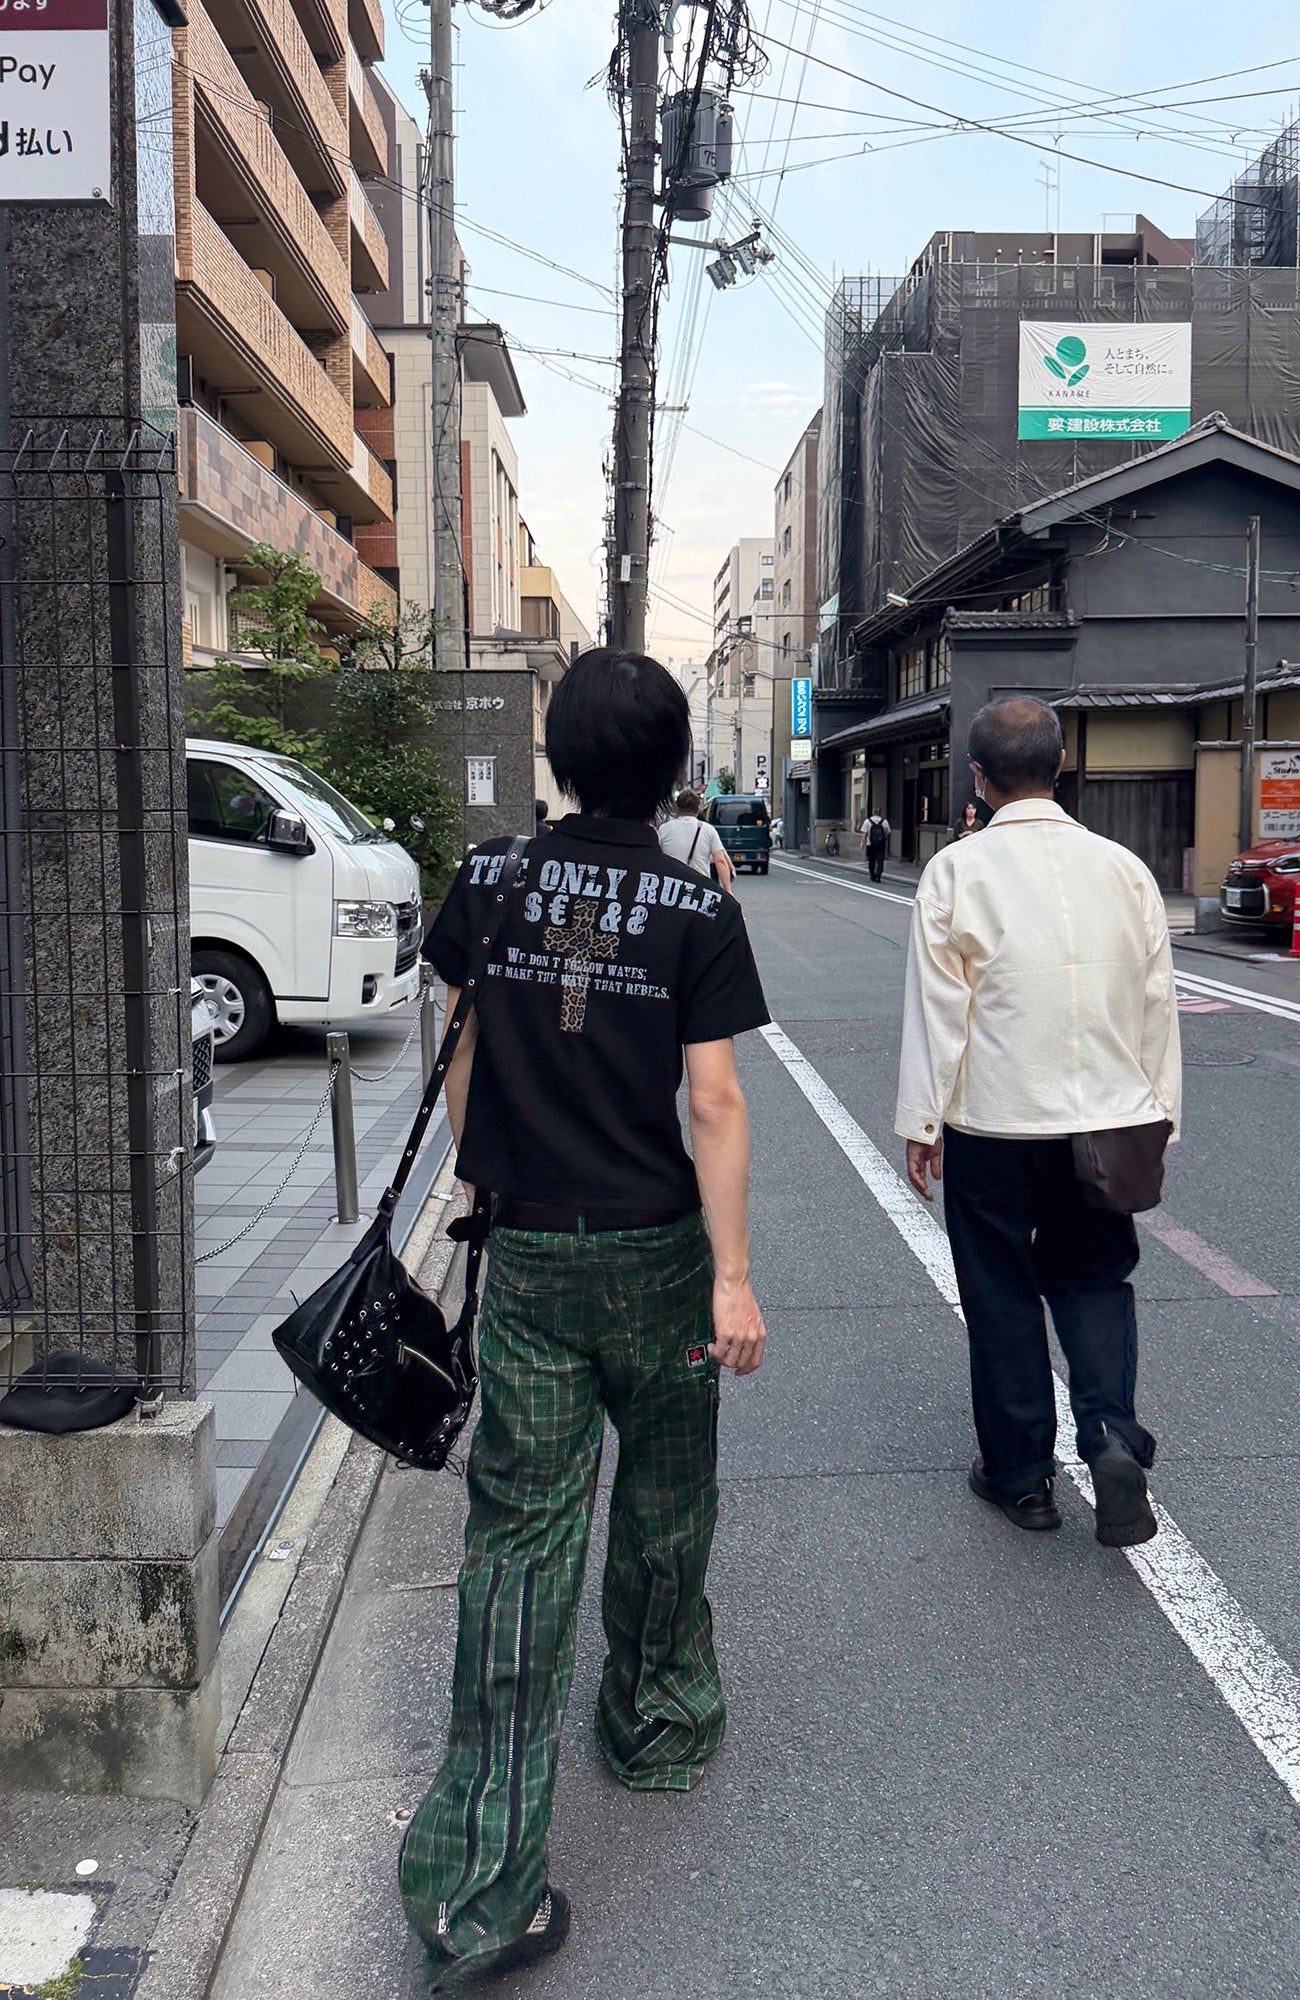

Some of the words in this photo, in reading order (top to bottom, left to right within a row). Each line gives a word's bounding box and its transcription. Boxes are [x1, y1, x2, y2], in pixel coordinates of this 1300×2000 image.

[704, 151, 717, 167] 75
[756, 755, 767, 768] P
[539, 859, 627, 900] ONLY
[634, 871, 722, 920] RULE
[487, 963, 503, 976] WE
[505, 966, 534, 981] MAKE
